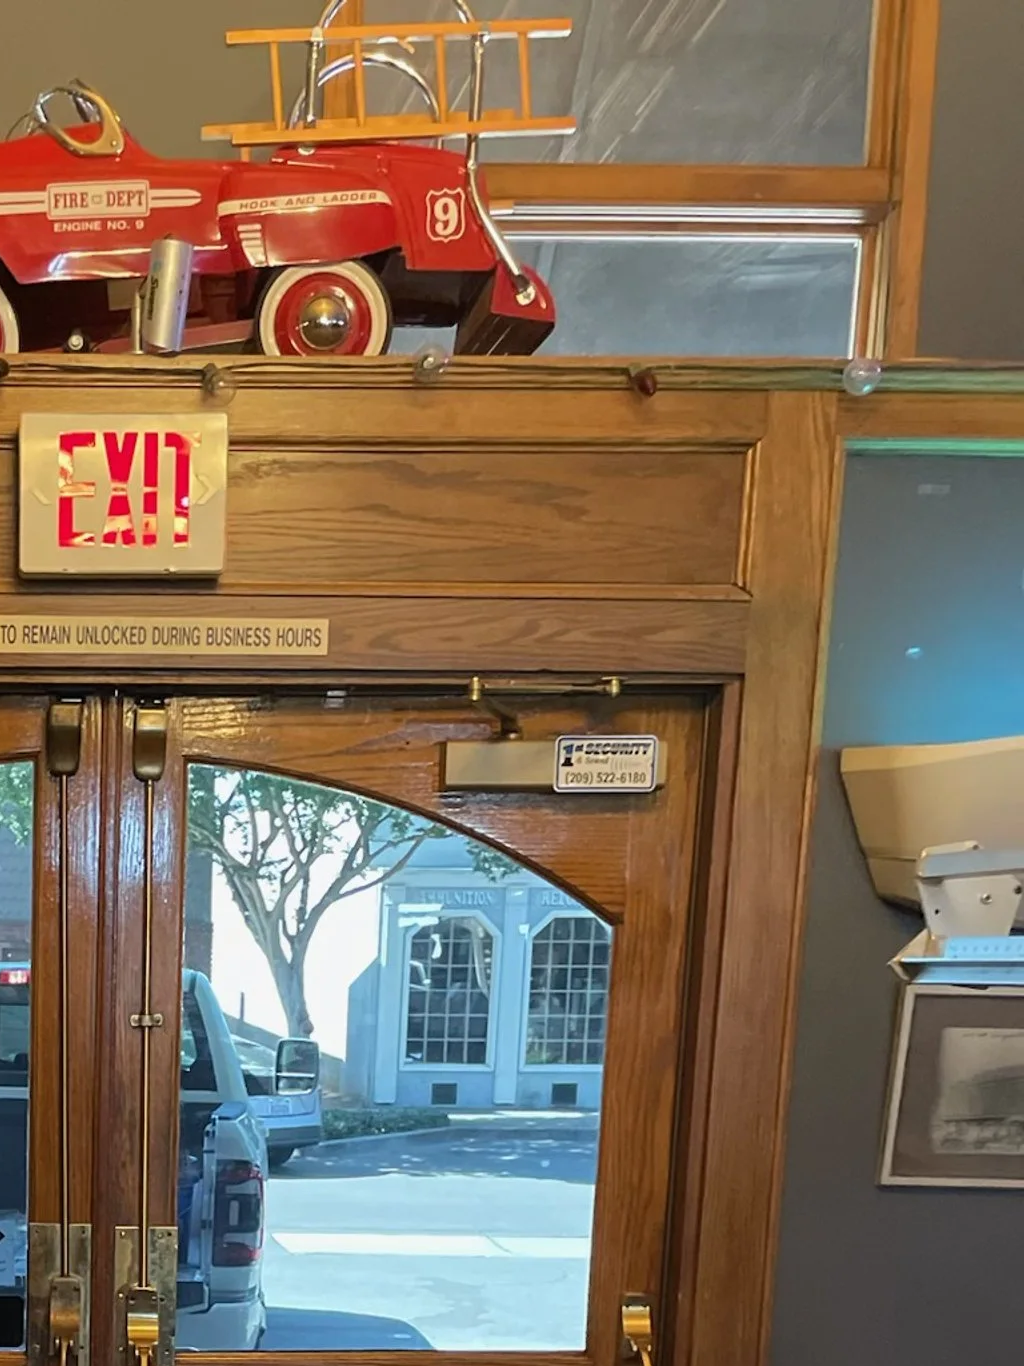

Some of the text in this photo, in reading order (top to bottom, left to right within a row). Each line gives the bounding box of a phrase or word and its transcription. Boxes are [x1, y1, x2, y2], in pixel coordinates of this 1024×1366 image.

[53, 189, 144, 209] FIRE DEPT
[239, 192, 378, 210] HOOK AND LADDER
[53, 219, 144, 232] ENGINE NO. 9
[433, 197, 459, 236] 9
[58, 431, 199, 548] EXIT
[0, 624, 17, 645] TO
[22, 624, 71, 645] REMAIN
[75, 625, 147, 646] UNLOCKED
[151, 626, 201, 646] DURING
[206, 626, 271, 647] BUSINESS
[275, 627, 322, 648] HOURS
[585, 742, 652, 755] SECURITY
[565, 771, 648, 785] (209) 522-6180
